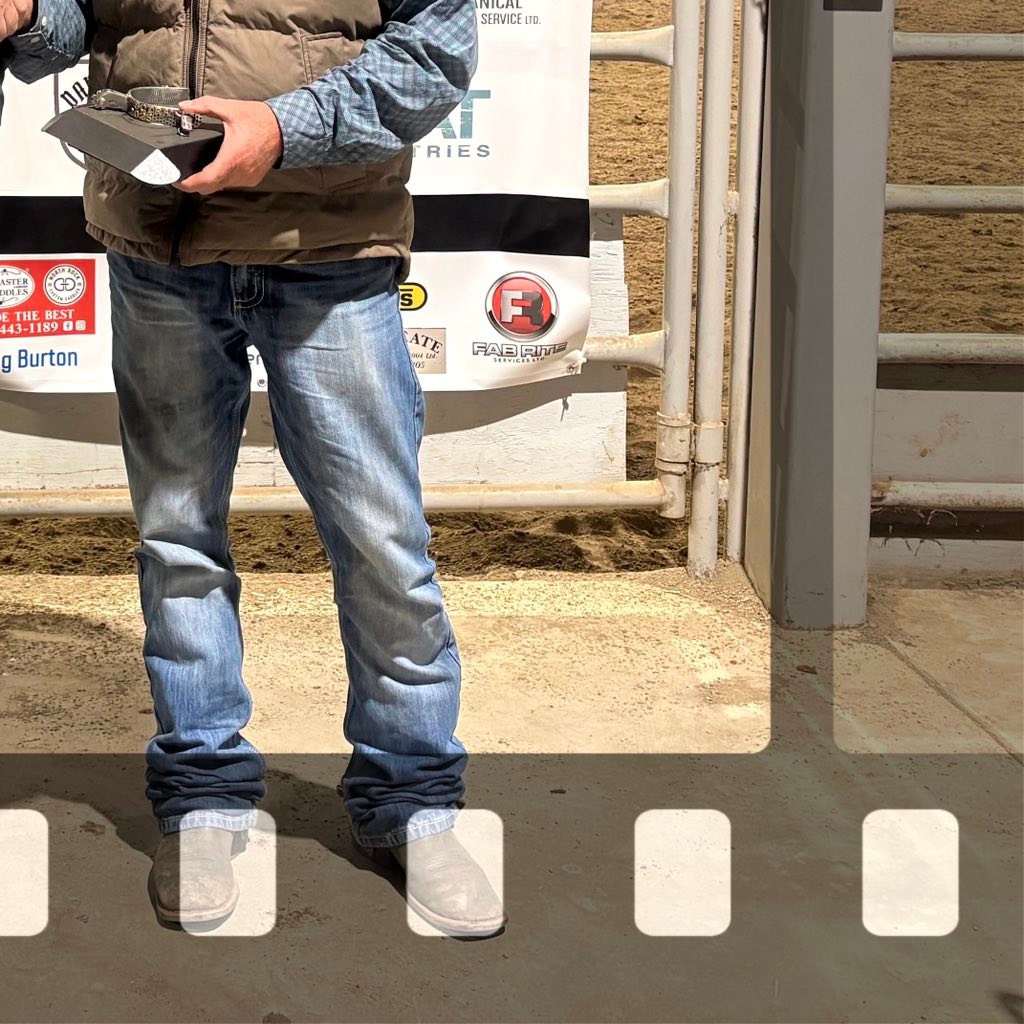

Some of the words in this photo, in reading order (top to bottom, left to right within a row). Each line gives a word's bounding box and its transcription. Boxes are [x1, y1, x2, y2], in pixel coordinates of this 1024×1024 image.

[480, 13, 522, 25] SERVICE
[525, 15, 542, 25] LTD.
[14, 310, 40, 322] THE
[45, 308, 75, 320] BEST
[404, 330, 443, 354] ATE
[472, 341, 518, 357] FAB
[520, 342, 568, 358] RITE
[18, 348, 78, 369] Burton
